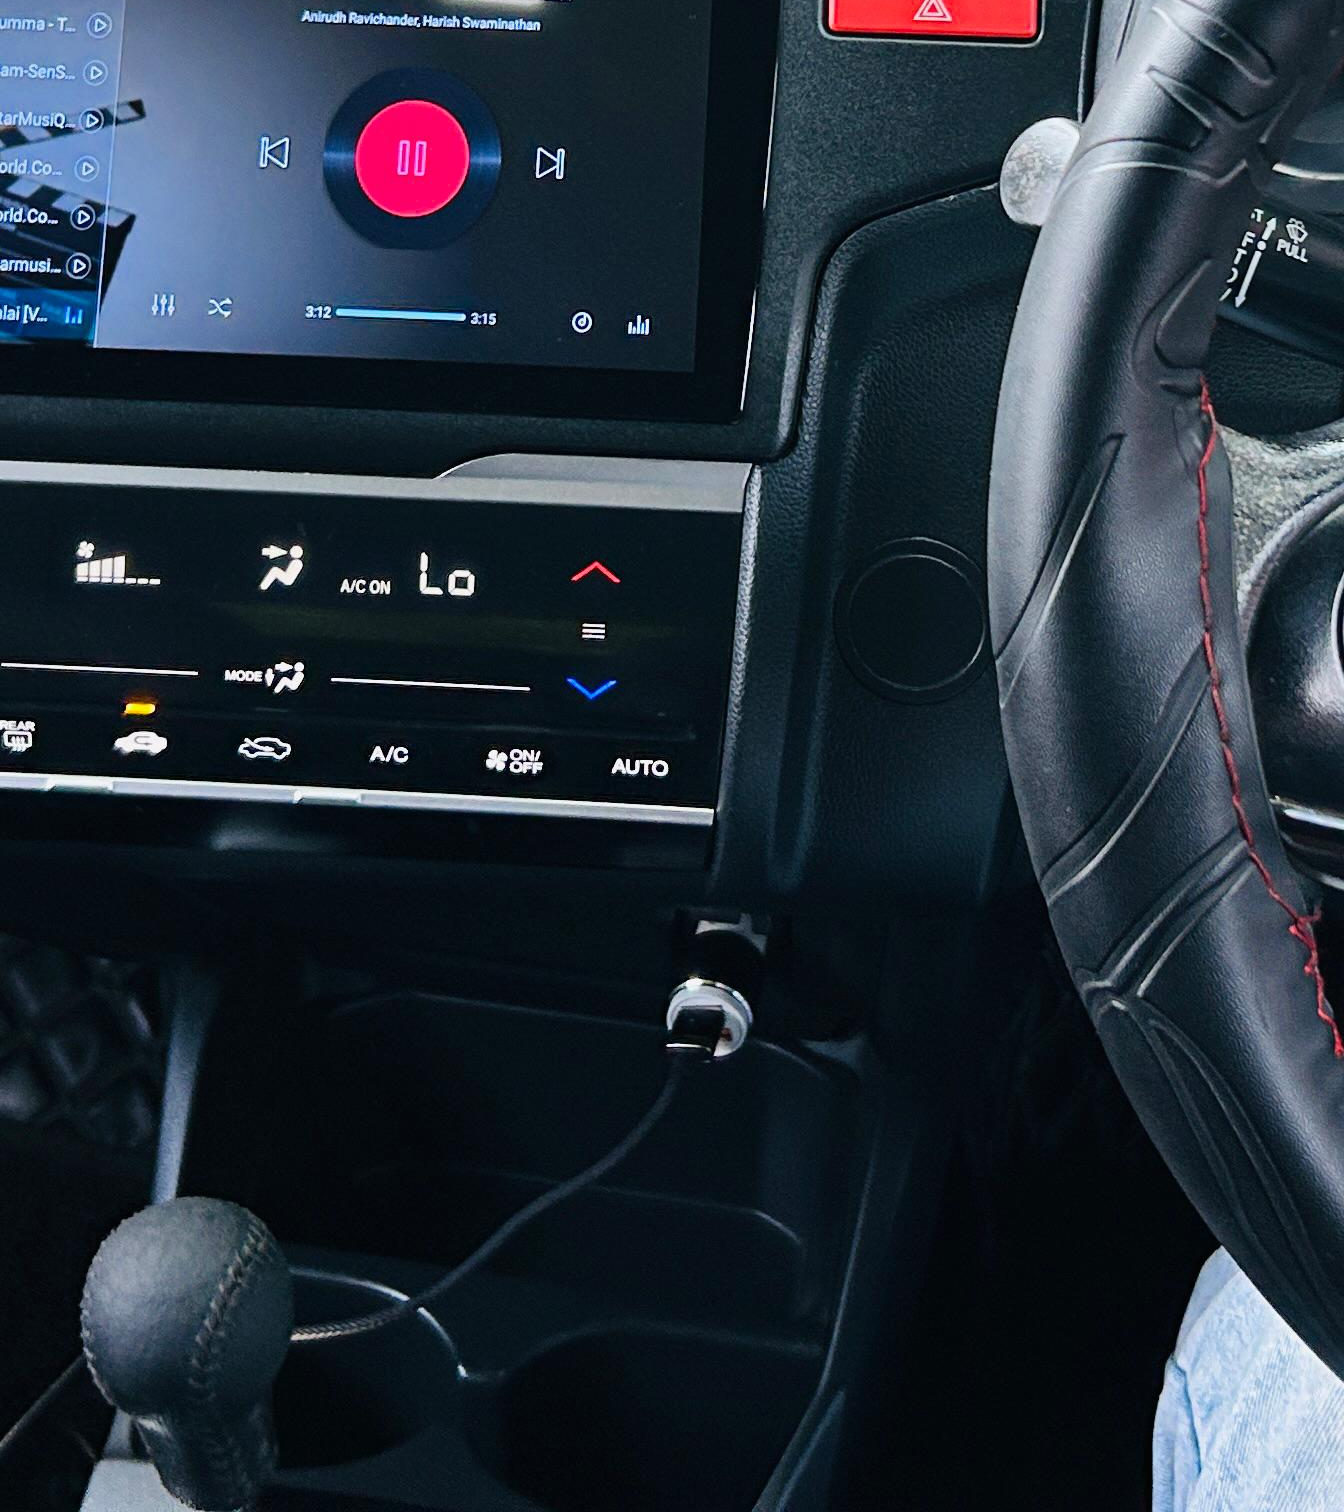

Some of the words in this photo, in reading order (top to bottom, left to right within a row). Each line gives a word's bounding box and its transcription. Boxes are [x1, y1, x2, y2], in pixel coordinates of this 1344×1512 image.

[301, 10, 347, 24] Anirudh
[422, 15, 459, 28] Harish
[462, 17, 541, 32] Swaminathan
[1276, 238, 1309, 263] PULL
[305, 305, 332, 319] 3:12
[470, 313, 497, 326] 3:15
[340, 579, 366, 595] A/C
[369, 579, 391, 595] ON
[224, 669, 262, 683] MODE
[369, 745, 409, 764] A/C
[509, 749, 540, 762] ON/
[509, 761, 543, 775] OFF
[611, 757, 670, 778] AUTO
